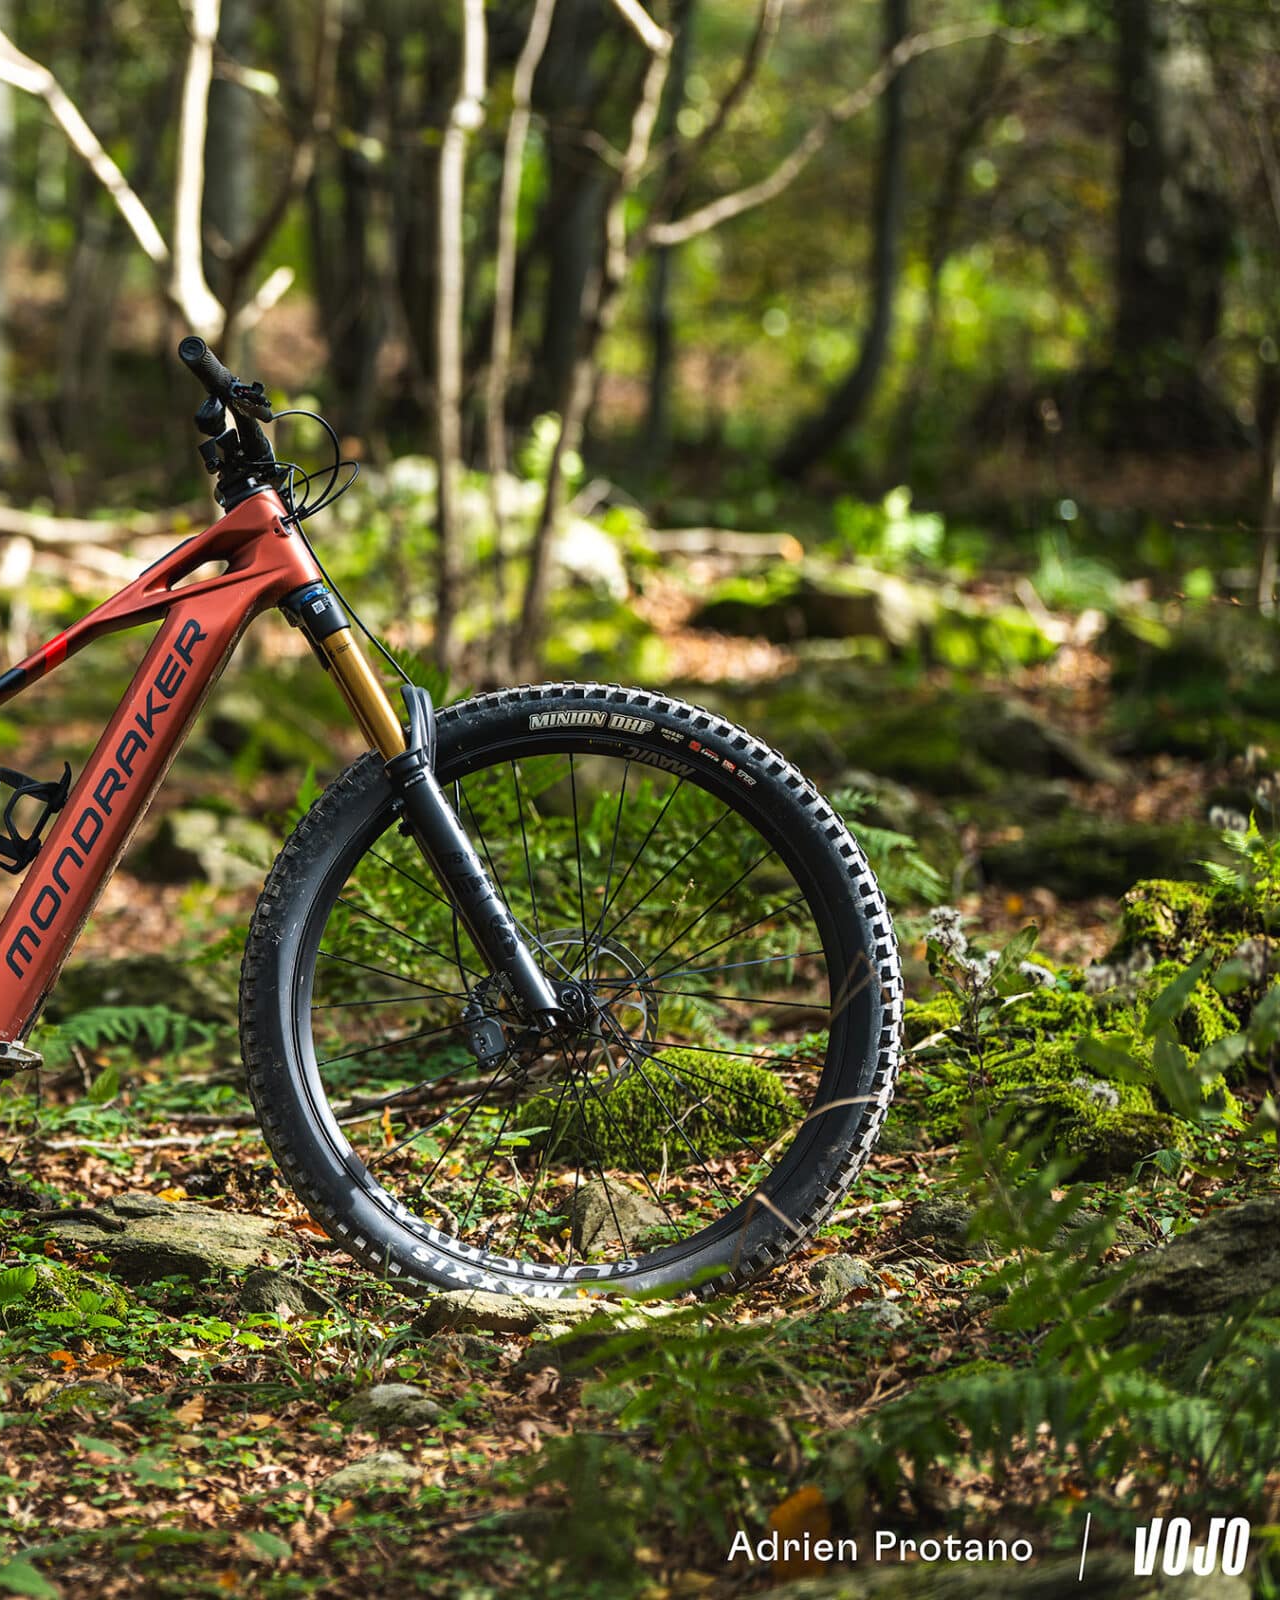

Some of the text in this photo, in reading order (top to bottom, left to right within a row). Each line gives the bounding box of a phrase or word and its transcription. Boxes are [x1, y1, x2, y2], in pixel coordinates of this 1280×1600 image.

[529, 710, 607, 731] MINION
[608, 713, 655, 735] DHF
[5, 618, 208, 979] MONDRAKER
[411, 1246, 564, 1299] MAXXIS
